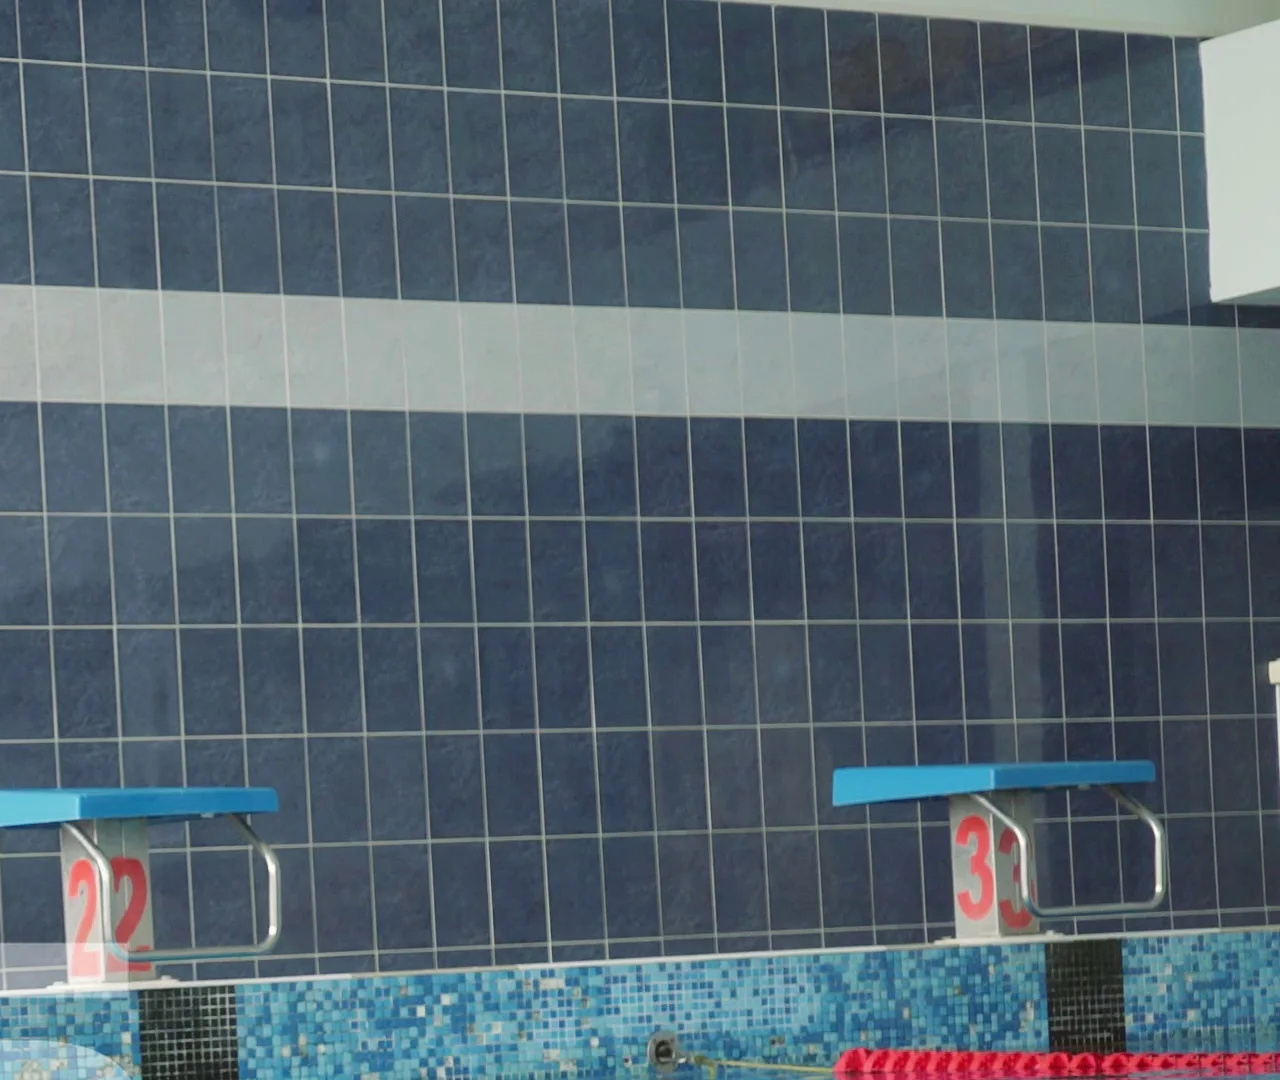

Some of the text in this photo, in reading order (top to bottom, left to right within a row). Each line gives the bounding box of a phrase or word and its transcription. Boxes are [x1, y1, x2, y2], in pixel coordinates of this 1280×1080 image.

[68, 859, 103, 977] 2
[107, 856, 153, 972] 2
[955, 814, 995, 921] 3
